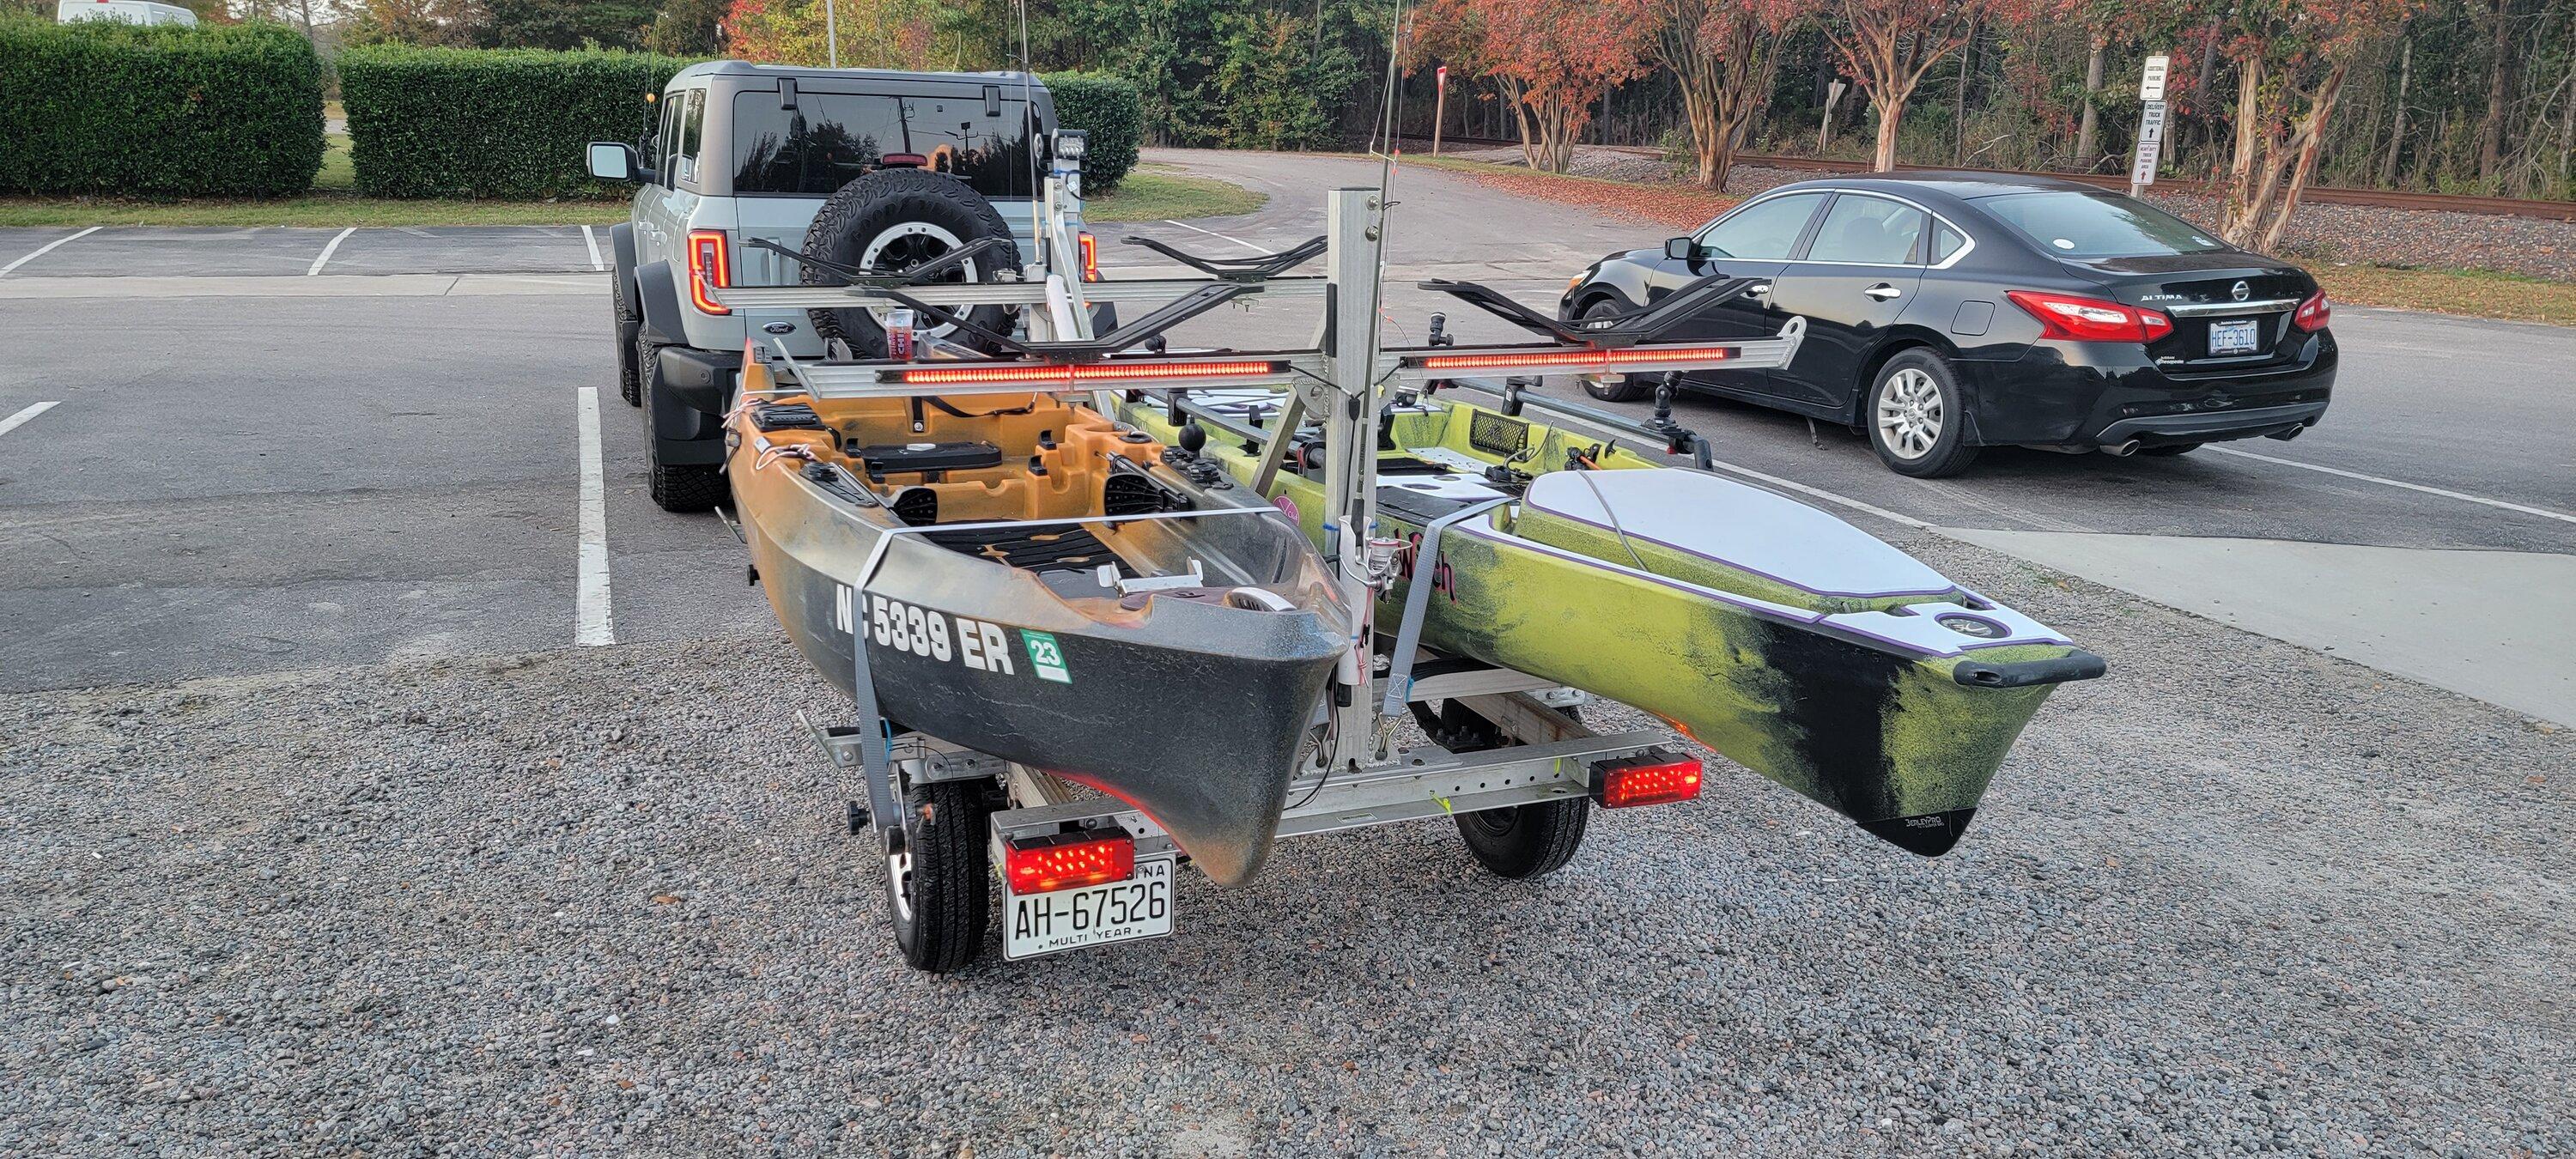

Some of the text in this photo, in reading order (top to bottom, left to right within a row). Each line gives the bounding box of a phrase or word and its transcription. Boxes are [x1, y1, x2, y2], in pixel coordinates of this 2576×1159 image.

[2211, 328, 2256, 348] HEF-3610
[872, 595, 952, 662] 5339
[956, 617, 1015, 675] ER
[1030, 640, 1061, 666] 23
[1015, 881, 1166, 941] AH-67526
[1049, 927, 1133, 949] MULTI YEAR
